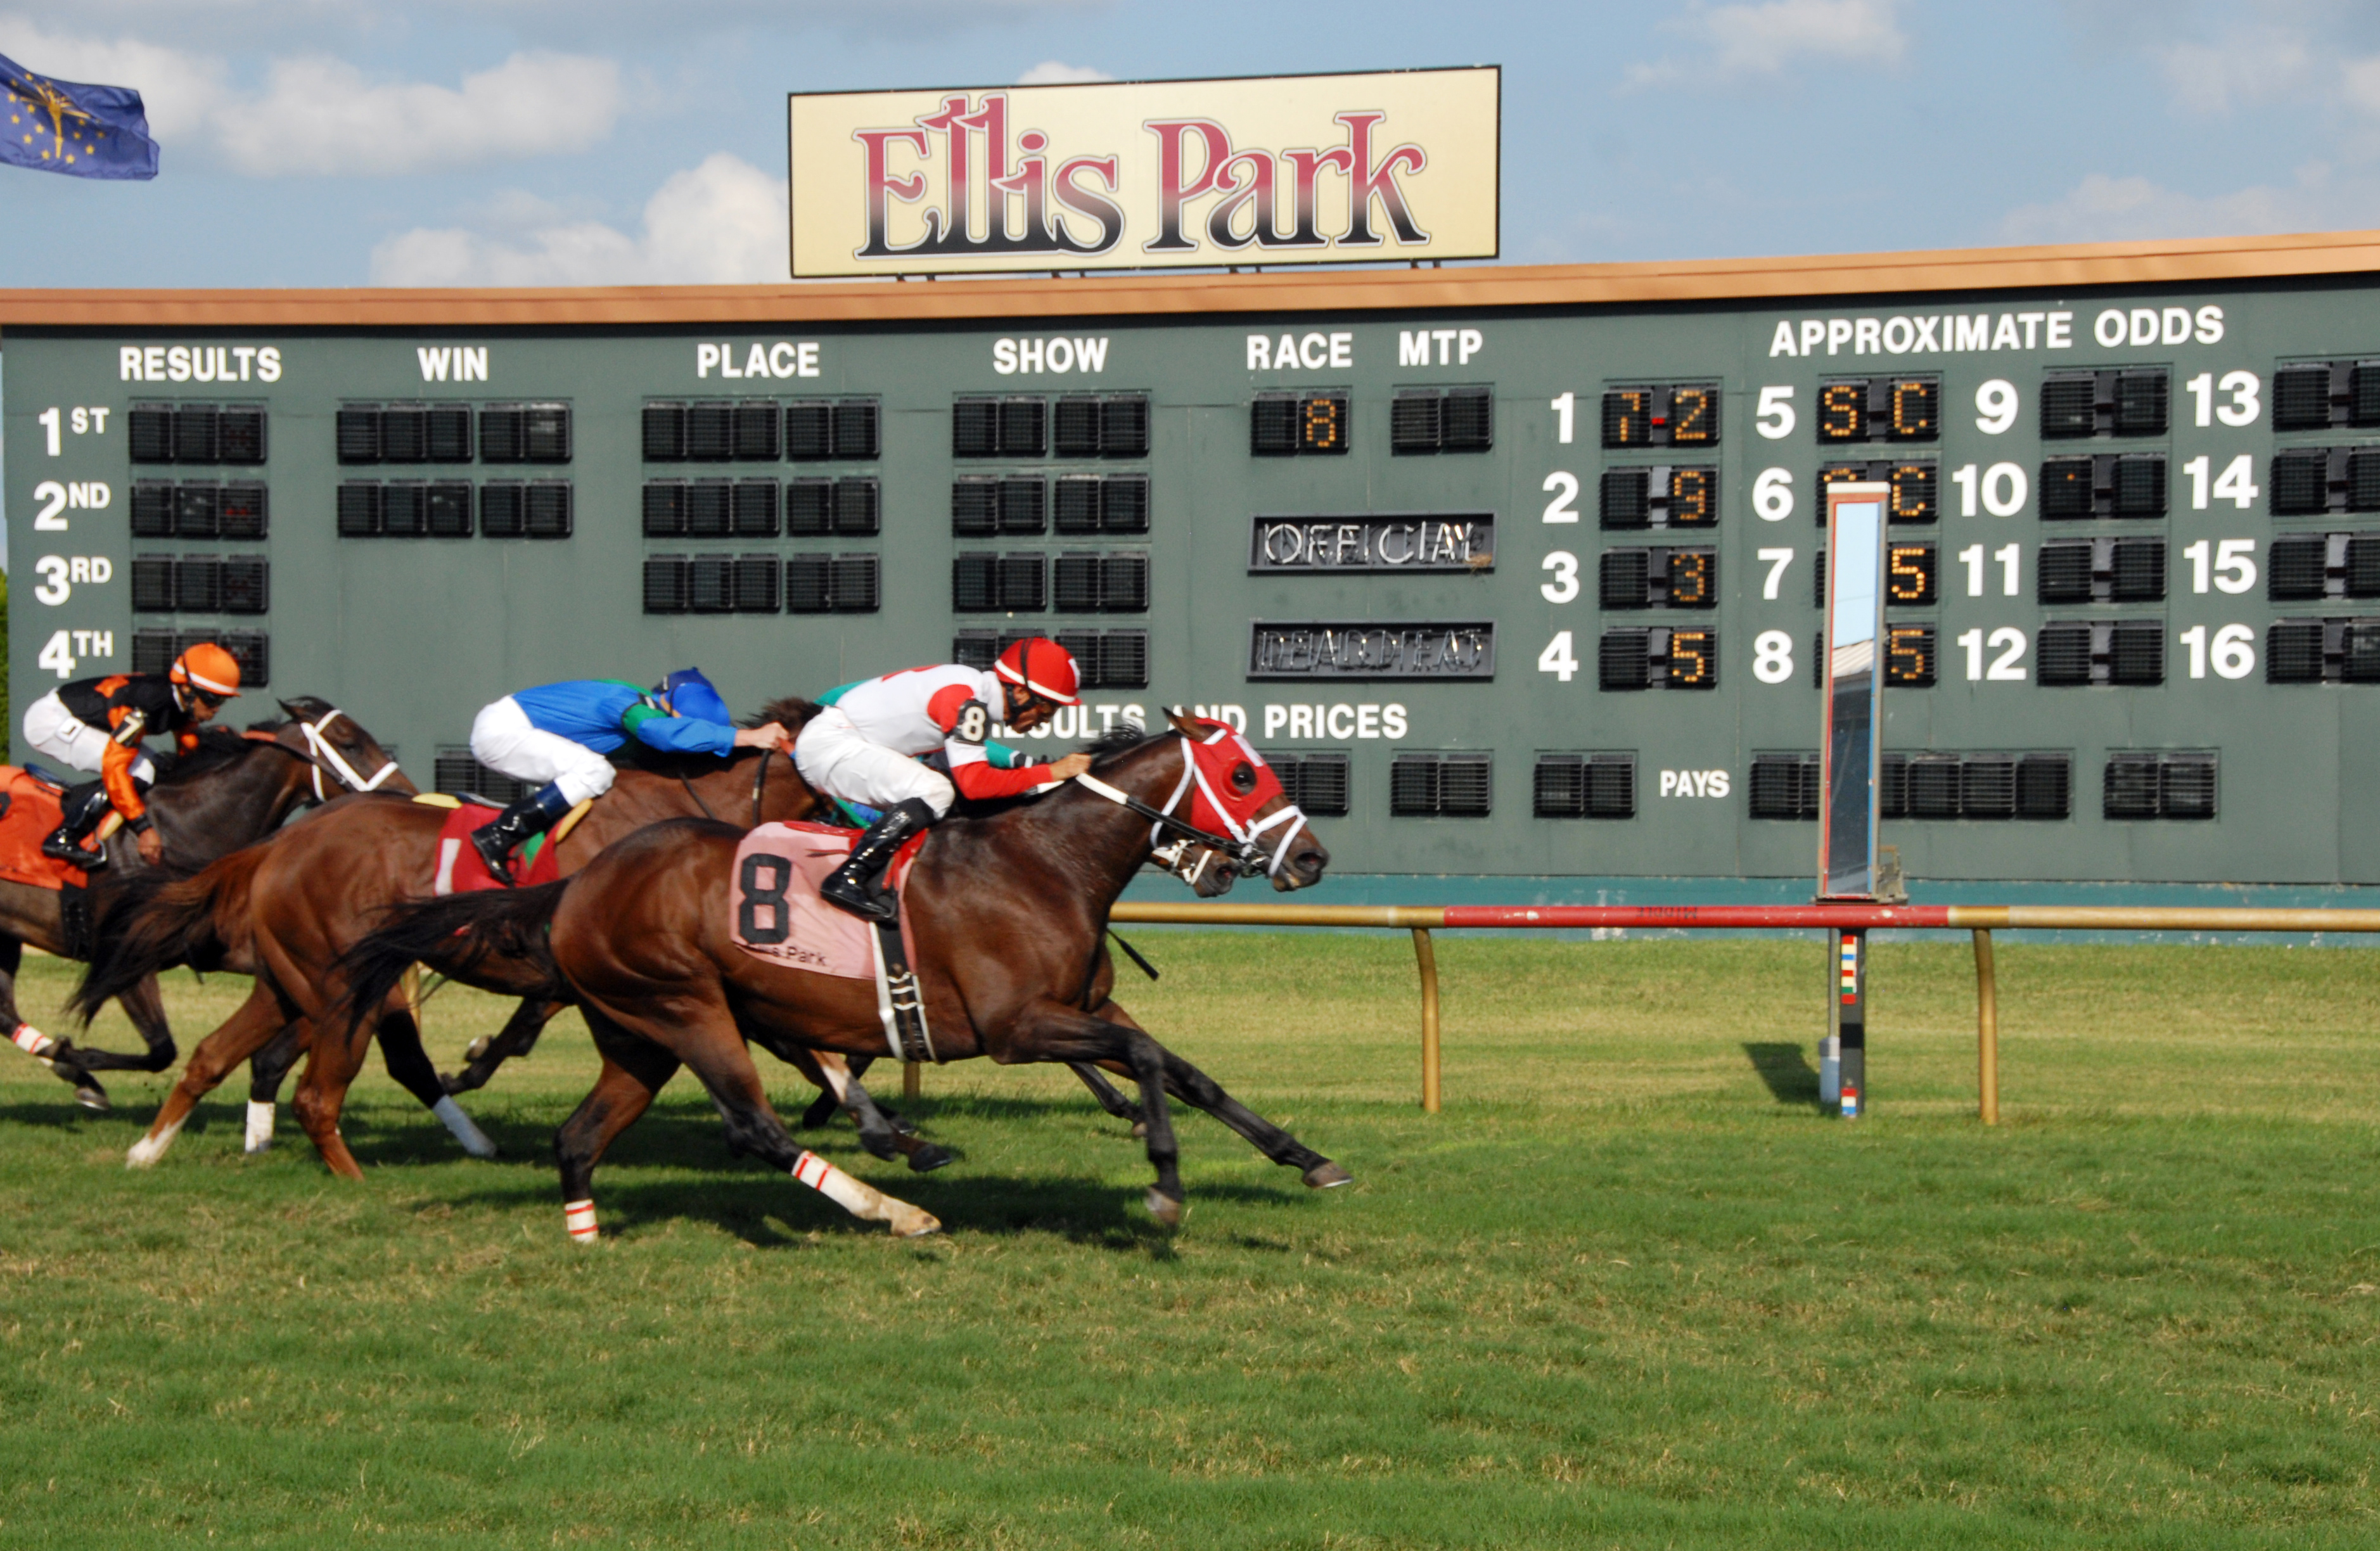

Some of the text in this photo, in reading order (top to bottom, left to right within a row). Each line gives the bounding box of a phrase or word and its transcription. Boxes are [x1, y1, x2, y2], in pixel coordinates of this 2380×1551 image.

[853, 93, 1431, 259] Ellis Park
[993, 337, 1108, 374] SHOW
[1246, 333, 1352, 369] RACE
[1399, 329, 1483, 366] MTP
[1770, 306, 2224, 357] APPROXIMATE ODDS
[120, 347, 281, 382] RESULTS
[417, 347, 487, 381] WIN
[698, 342, 819, 378] PLACE
[1306, 399, 1336, 447] 8
[1551, 392, 1573, 444] 1
[1756, 386, 1796, 439] 5
[1975, 379, 2019, 435] 9
[2187, 371, 2261, 427] 13
[39, 407, 109, 456] 1ST
[34, 481, 110, 530] 2ND
[1542, 471, 1579, 523] 2
[1674, 470, 1705, 520] 9
[1753, 467, 1794, 521] 6
[1952, 462, 2028, 517] 10
[2184, 455, 2259, 509] 14
[1264, 521, 1488, 564] OFFICIAL
[2184, 539, 2257, 594] 15
[35, 556, 112, 606] 3RD
[1540, 551, 1580, 604] 3
[1673, 554, 1705, 601] 3
[1758, 548, 1794, 600] 7
[1891, 547, 1926, 599] 5
[1959, 543, 2020, 596] 11
[39, 630, 113, 679] 4TH
[1539, 631, 1578, 682] 4
[1673, 632, 1705, 682] 5
[1753, 630, 1794, 684] 8
[1891, 629, 1924, 679] 5
[1958, 627, 2026, 680] 12
[2180, 623, 2256, 679] 16
[115, 715, 143, 744] 7
[961, 706, 986, 741] 8
[1265, 703, 1408, 739] PRICES
[1660, 770, 1730, 798] PAYS
[739, 853, 791, 944] 8
